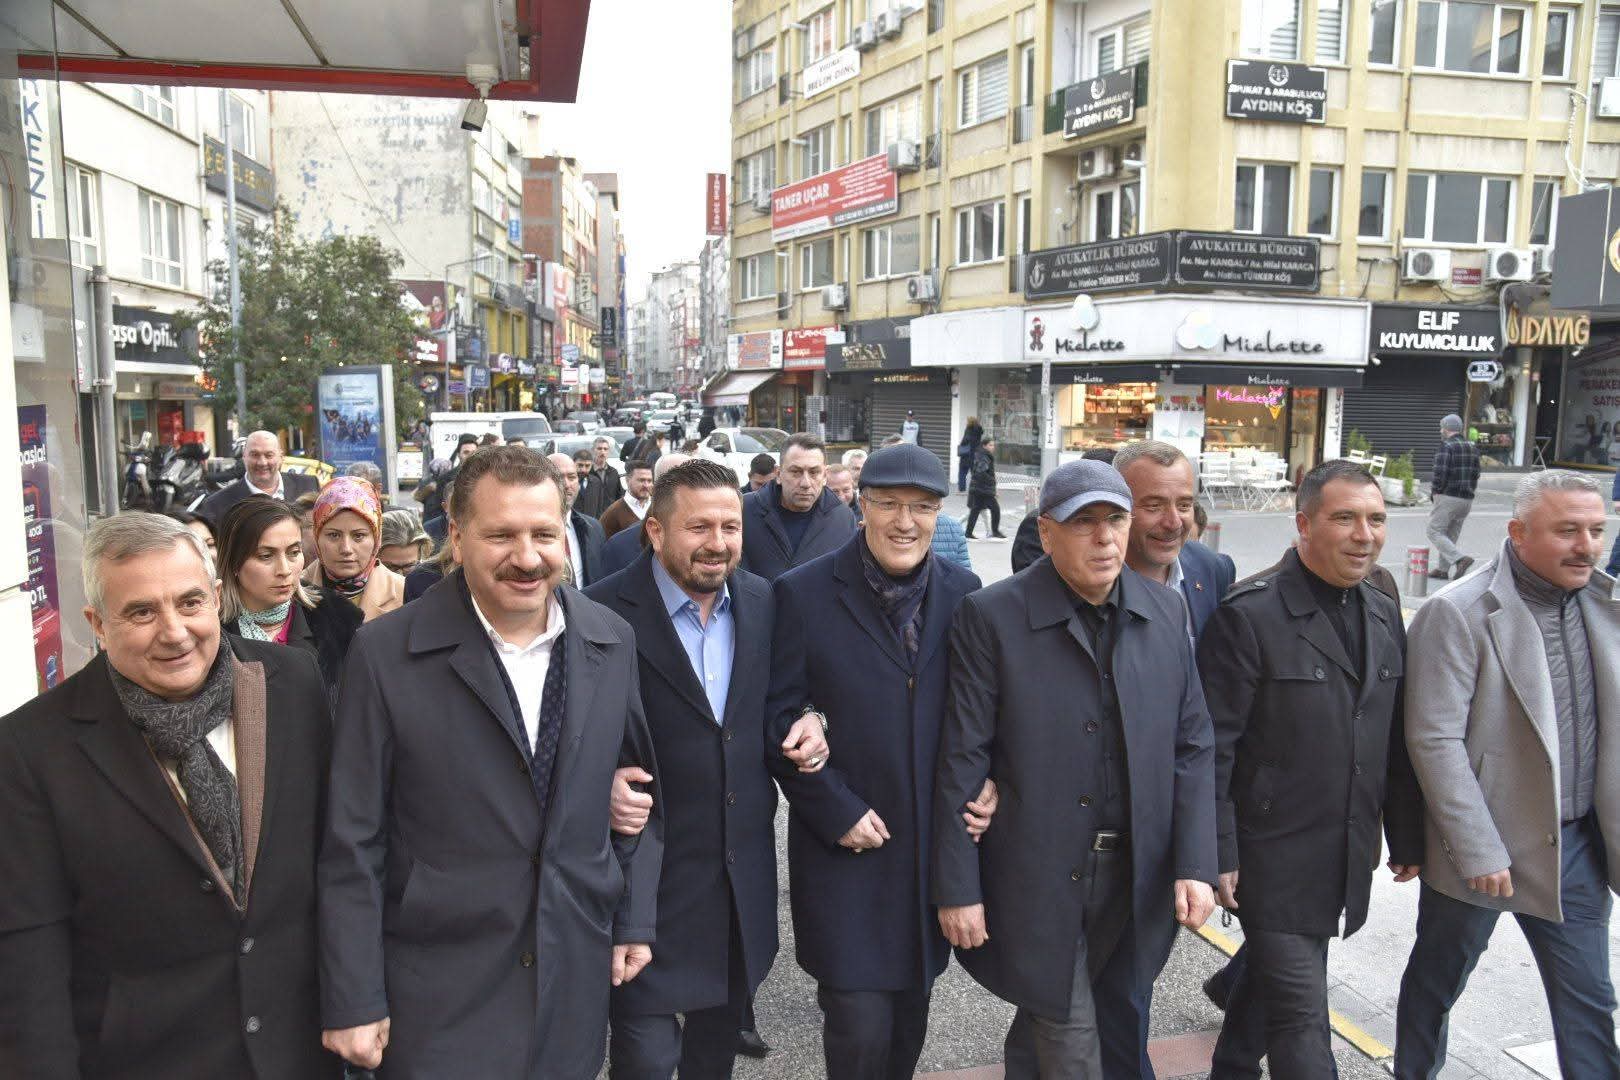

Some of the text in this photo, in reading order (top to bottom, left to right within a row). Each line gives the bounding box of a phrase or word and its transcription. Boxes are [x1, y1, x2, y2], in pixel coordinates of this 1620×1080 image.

[1072, 111, 1102, 131] AYDIN
[1103, 104, 1124, 121] KÖŞ
[1241, 98, 1313, 118] AYDIN KÖŞ
[774, 191, 802, 213] TANER
[802, 182, 830, 208] UÇAR
[1054, 240, 1158, 266] AVUKATLIK BÜROSU
[1189, 239, 1307, 256] AVUKATLIK BÜROSU
[1180, 256, 1193, 265] Av.
[1195, 257, 1208, 266] Nur
[1250, 260, 1262, 268] Av.
[1263, 260, 1280, 269] Hilal
[1124, 272, 1140, 283] KÖŞ
[1203, 270, 1216, 279] Av.
[1243, 270, 1274, 281] TÜRKER
[1275, 272, 1291, 284] KÖŞ
[1055, 330, 1125, 354] Mialatte
[1223, 330, 1324, 354] Mialatte
[1380, 332, 1495, 352] KUYUMCULUK
[1073, 372, 1104, 383] Mialatte
[1247, 373, 1290, 385] Mialatte
